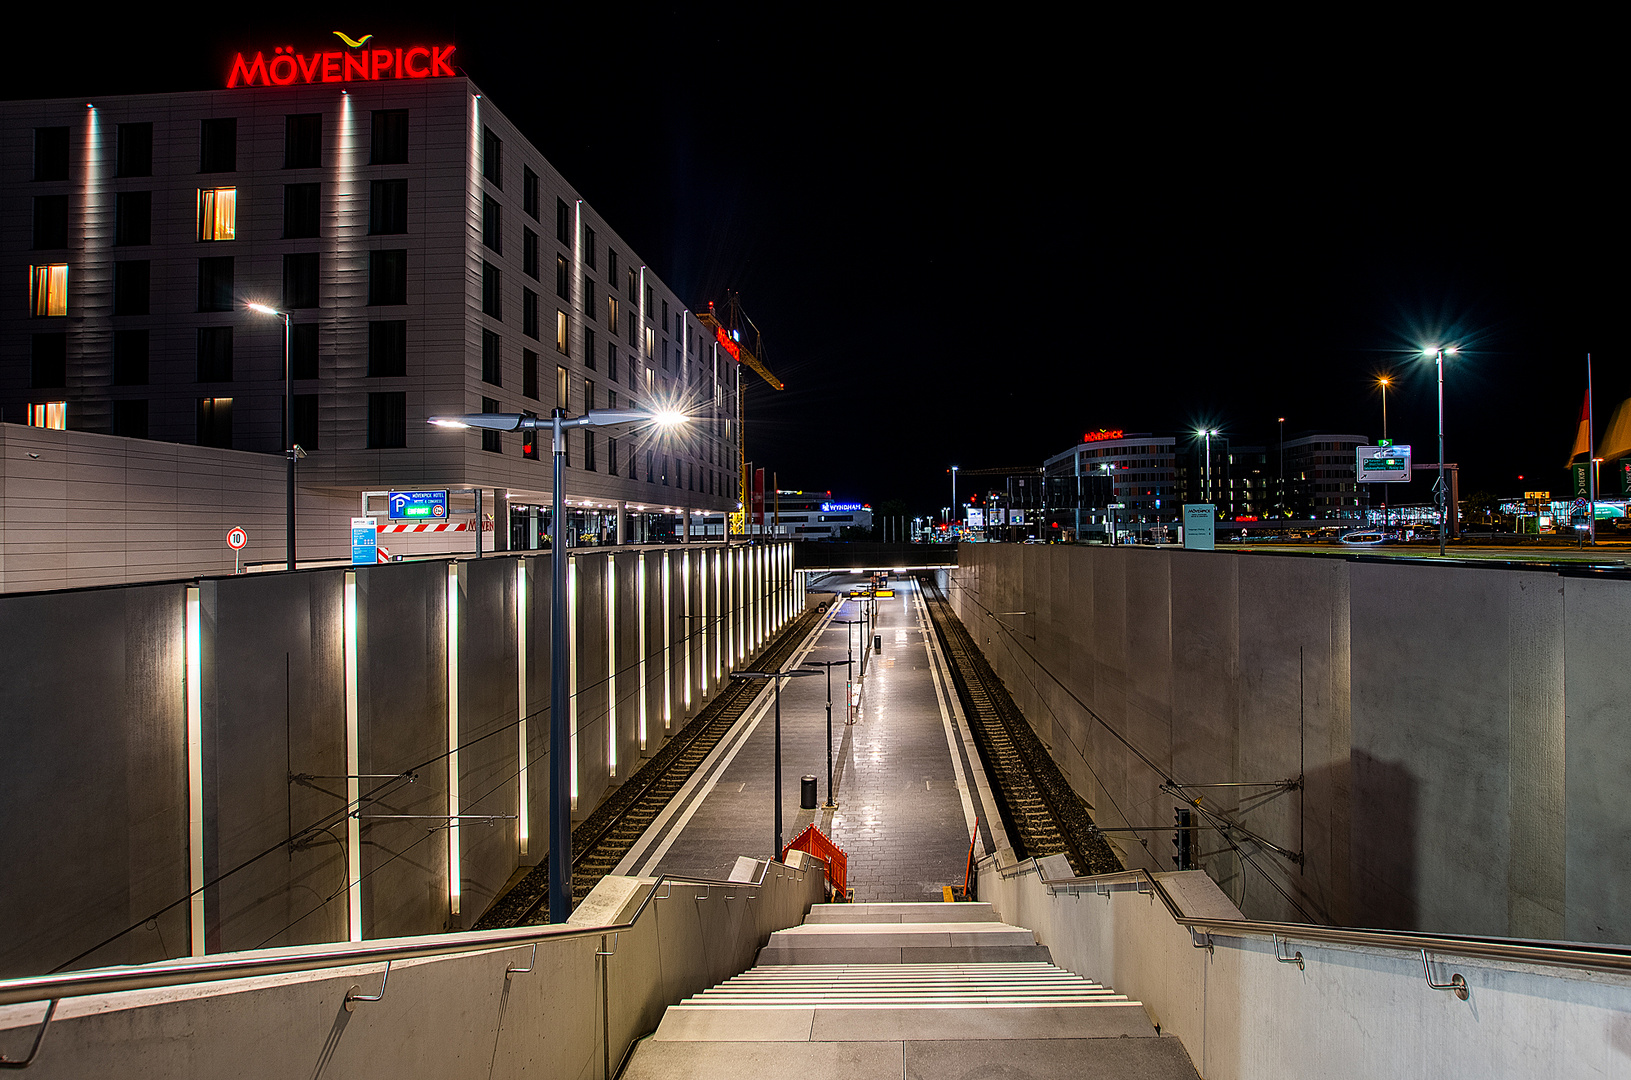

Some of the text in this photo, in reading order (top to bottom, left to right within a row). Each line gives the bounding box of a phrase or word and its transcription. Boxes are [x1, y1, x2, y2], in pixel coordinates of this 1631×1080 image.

[226, 46, 455, 88] MÖVENPICK
[1084, 430, 1123, 442] MÖVENPICK
[233, 533, 241, 543] 10
